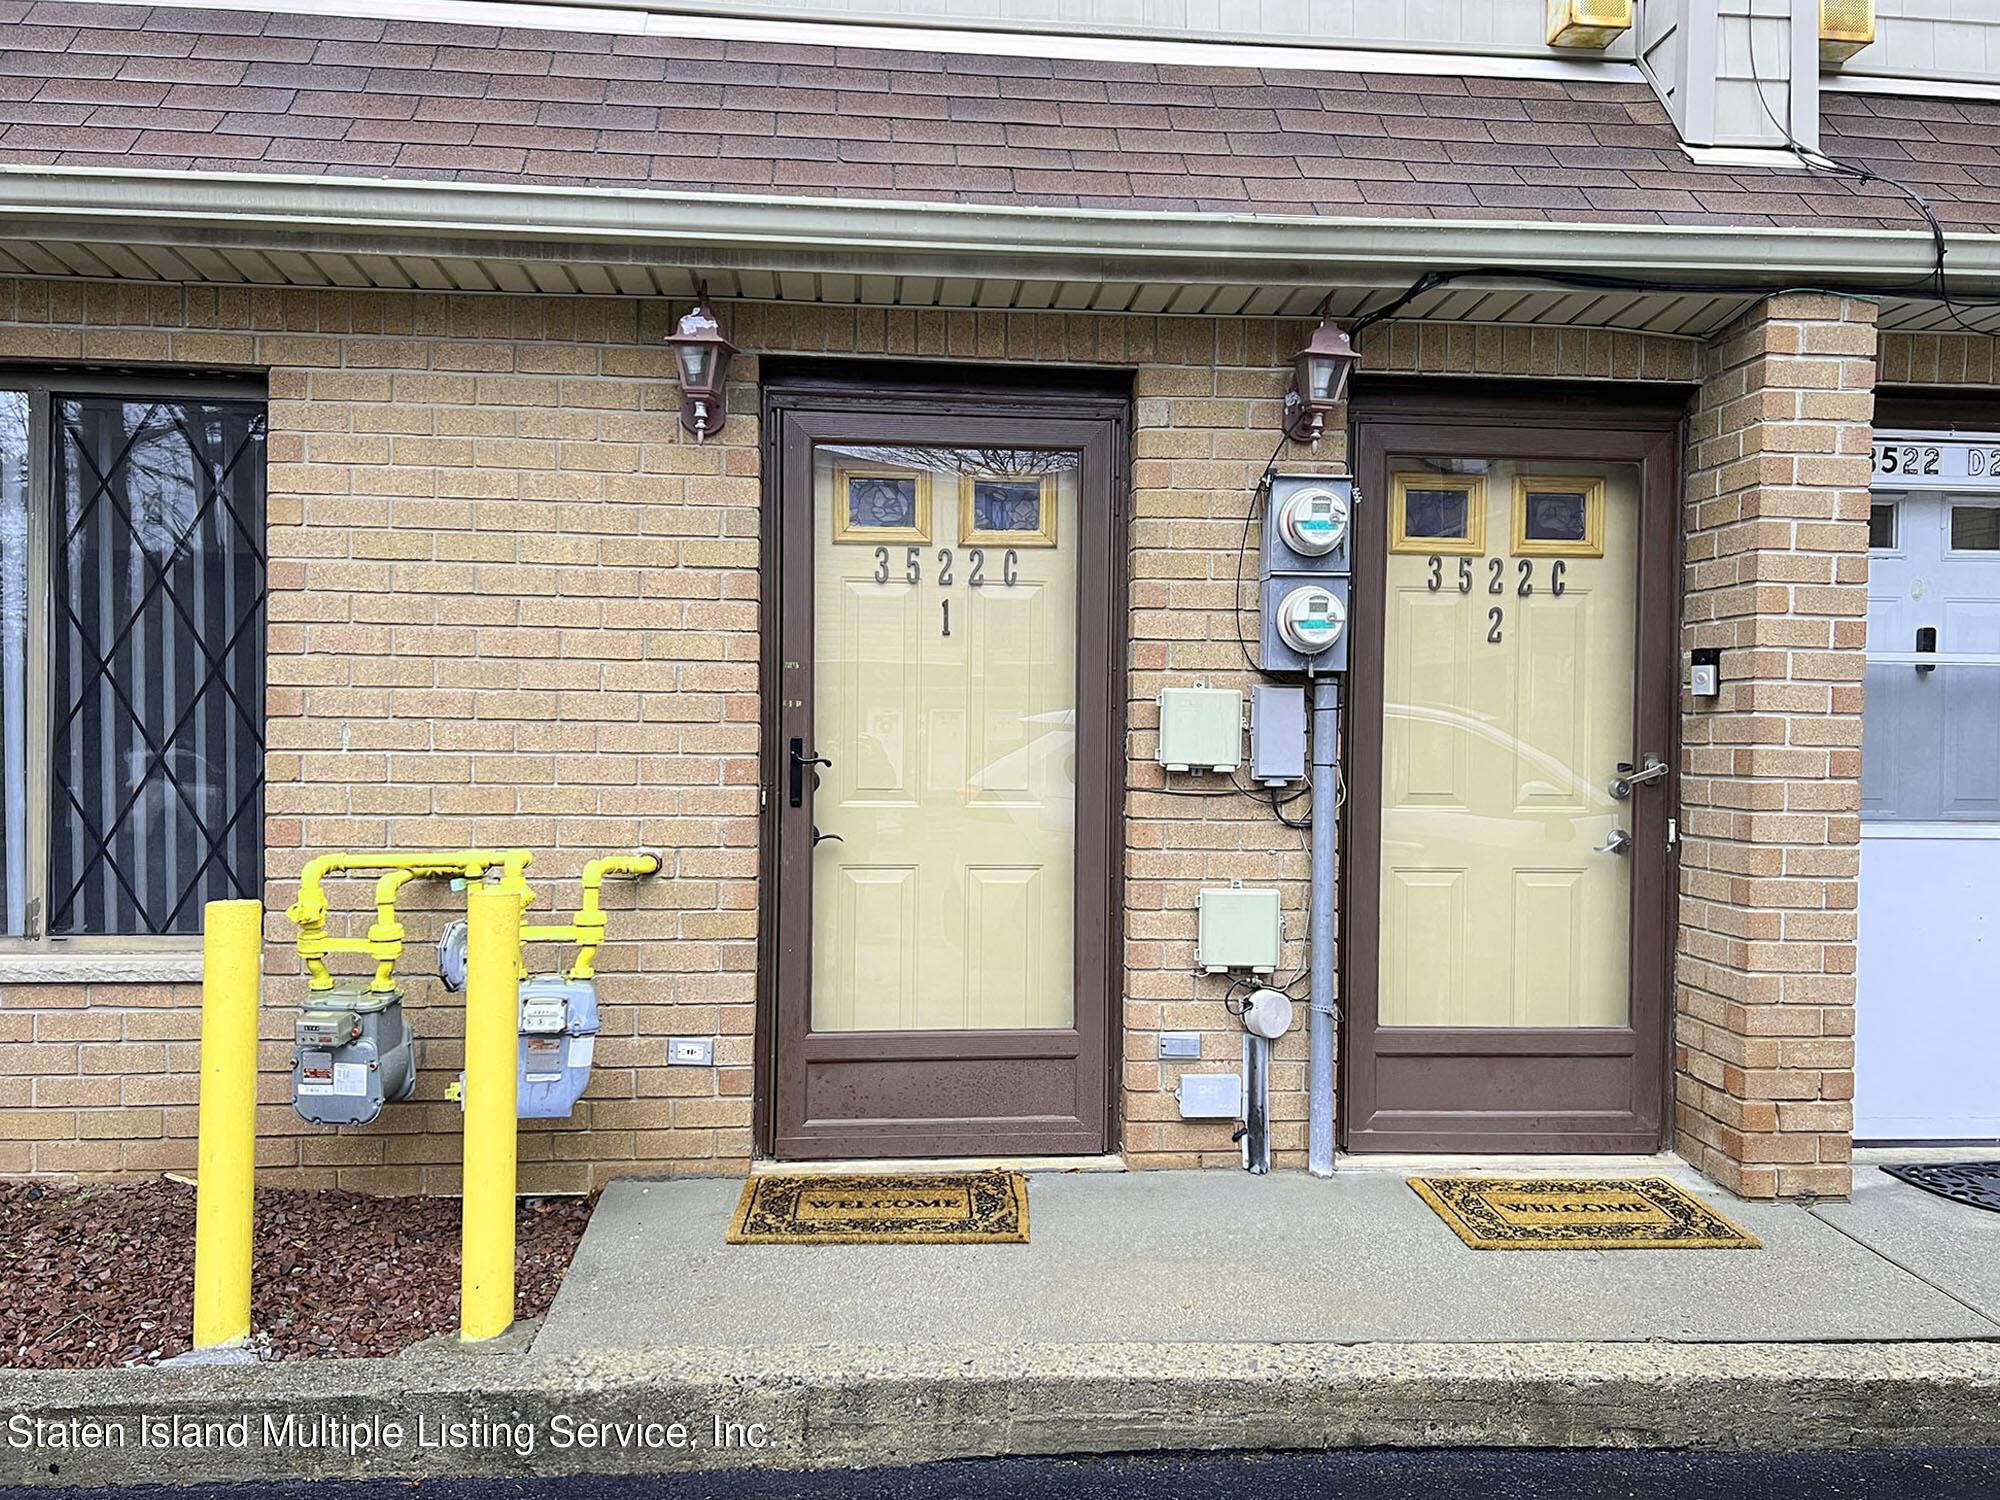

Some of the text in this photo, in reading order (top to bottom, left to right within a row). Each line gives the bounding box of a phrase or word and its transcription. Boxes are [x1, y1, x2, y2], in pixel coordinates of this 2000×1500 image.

[1967, 448, 2000, 477] D2
[874, 546, 1018, 586] 3522C
[1427, 554, 1566, 596] 3522C
[941, 598, 951, 636] 1
[1487, 606, 1503, 643] 2
[810, 1199, 962, 1209] WELCOME
[1499, 1202, 1653, 1214] WELCOME
